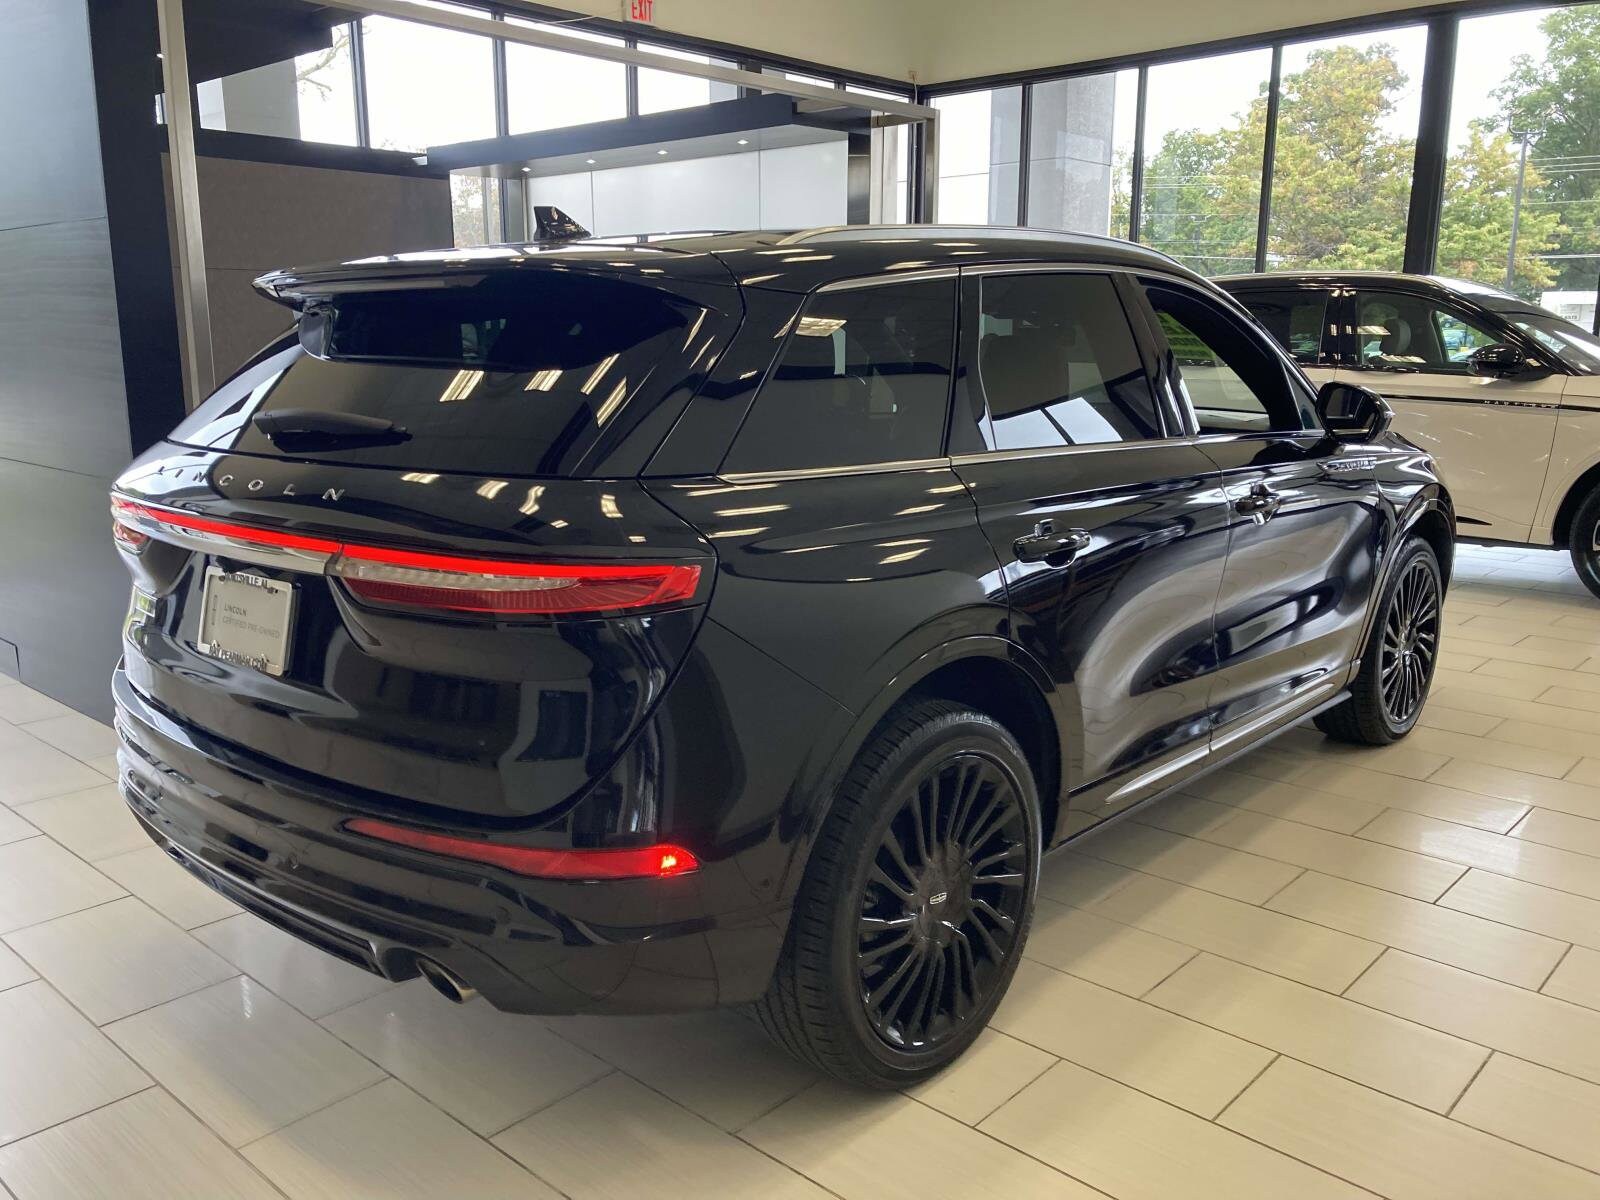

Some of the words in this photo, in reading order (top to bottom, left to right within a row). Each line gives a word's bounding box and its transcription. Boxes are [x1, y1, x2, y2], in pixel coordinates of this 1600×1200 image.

[632, 0, 652, 21] EXIT
[158, 465, 345, 501] LINCOLN
[224, 603, 247, 617] LINCOLN
